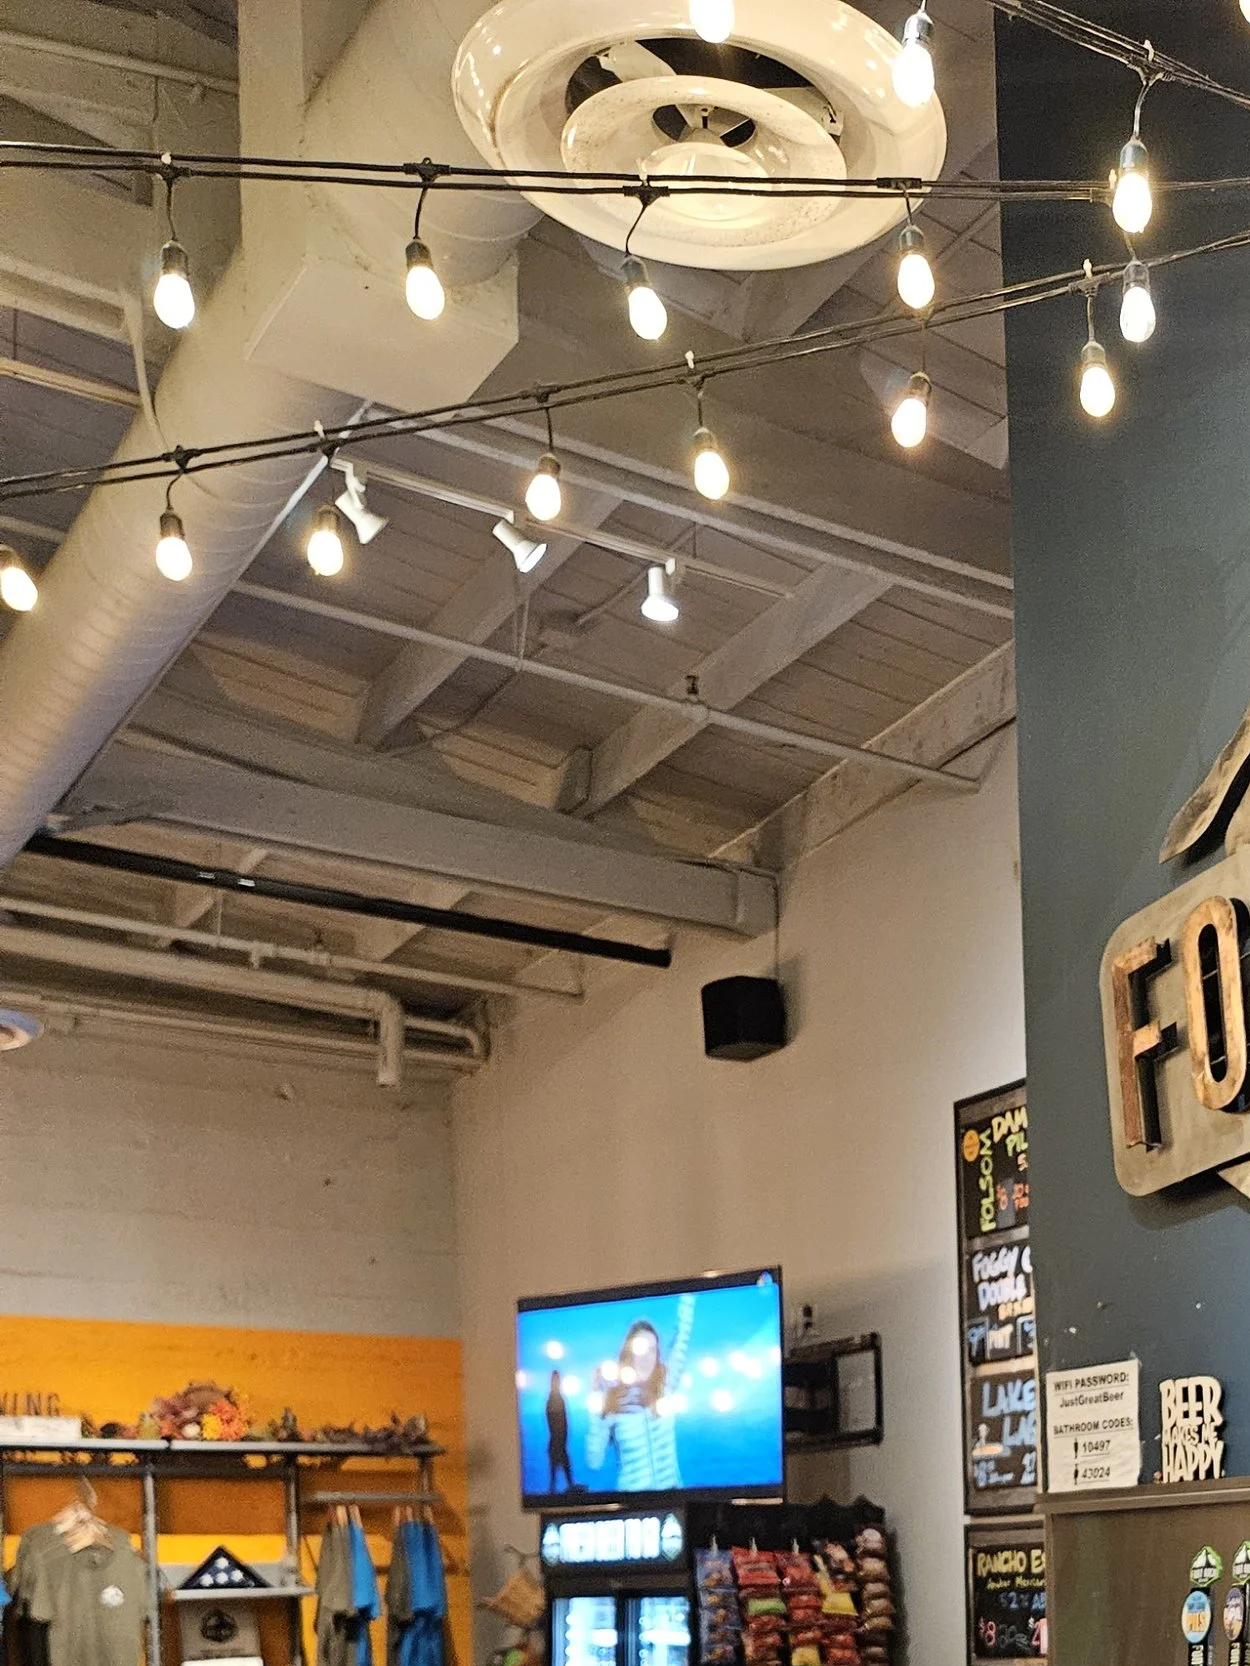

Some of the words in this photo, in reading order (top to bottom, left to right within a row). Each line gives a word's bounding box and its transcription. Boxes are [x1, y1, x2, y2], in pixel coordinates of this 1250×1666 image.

[979, 1127, 997, 1232] FOLSOM
[1054, 1379, 1073, 1391] WIFI
[1075, 1372, 1130, 1388] PASSWORD:
[1060, 1391, 1125, 1408] JustGreatBeer
[1160, 1376, 1223, 1429] BEER
[1053, 1422, 1100, 1435] BATHROOM
[1102, 1417, 1134, 1430] CODES:
[1163, 1424, 1199, 1446] MAKES
[1201, 1423, 1219, 1445] ME
[1082, 1440, 1111, 1453] 10497
[977, 1550, 1027, 1577] RANCHO
